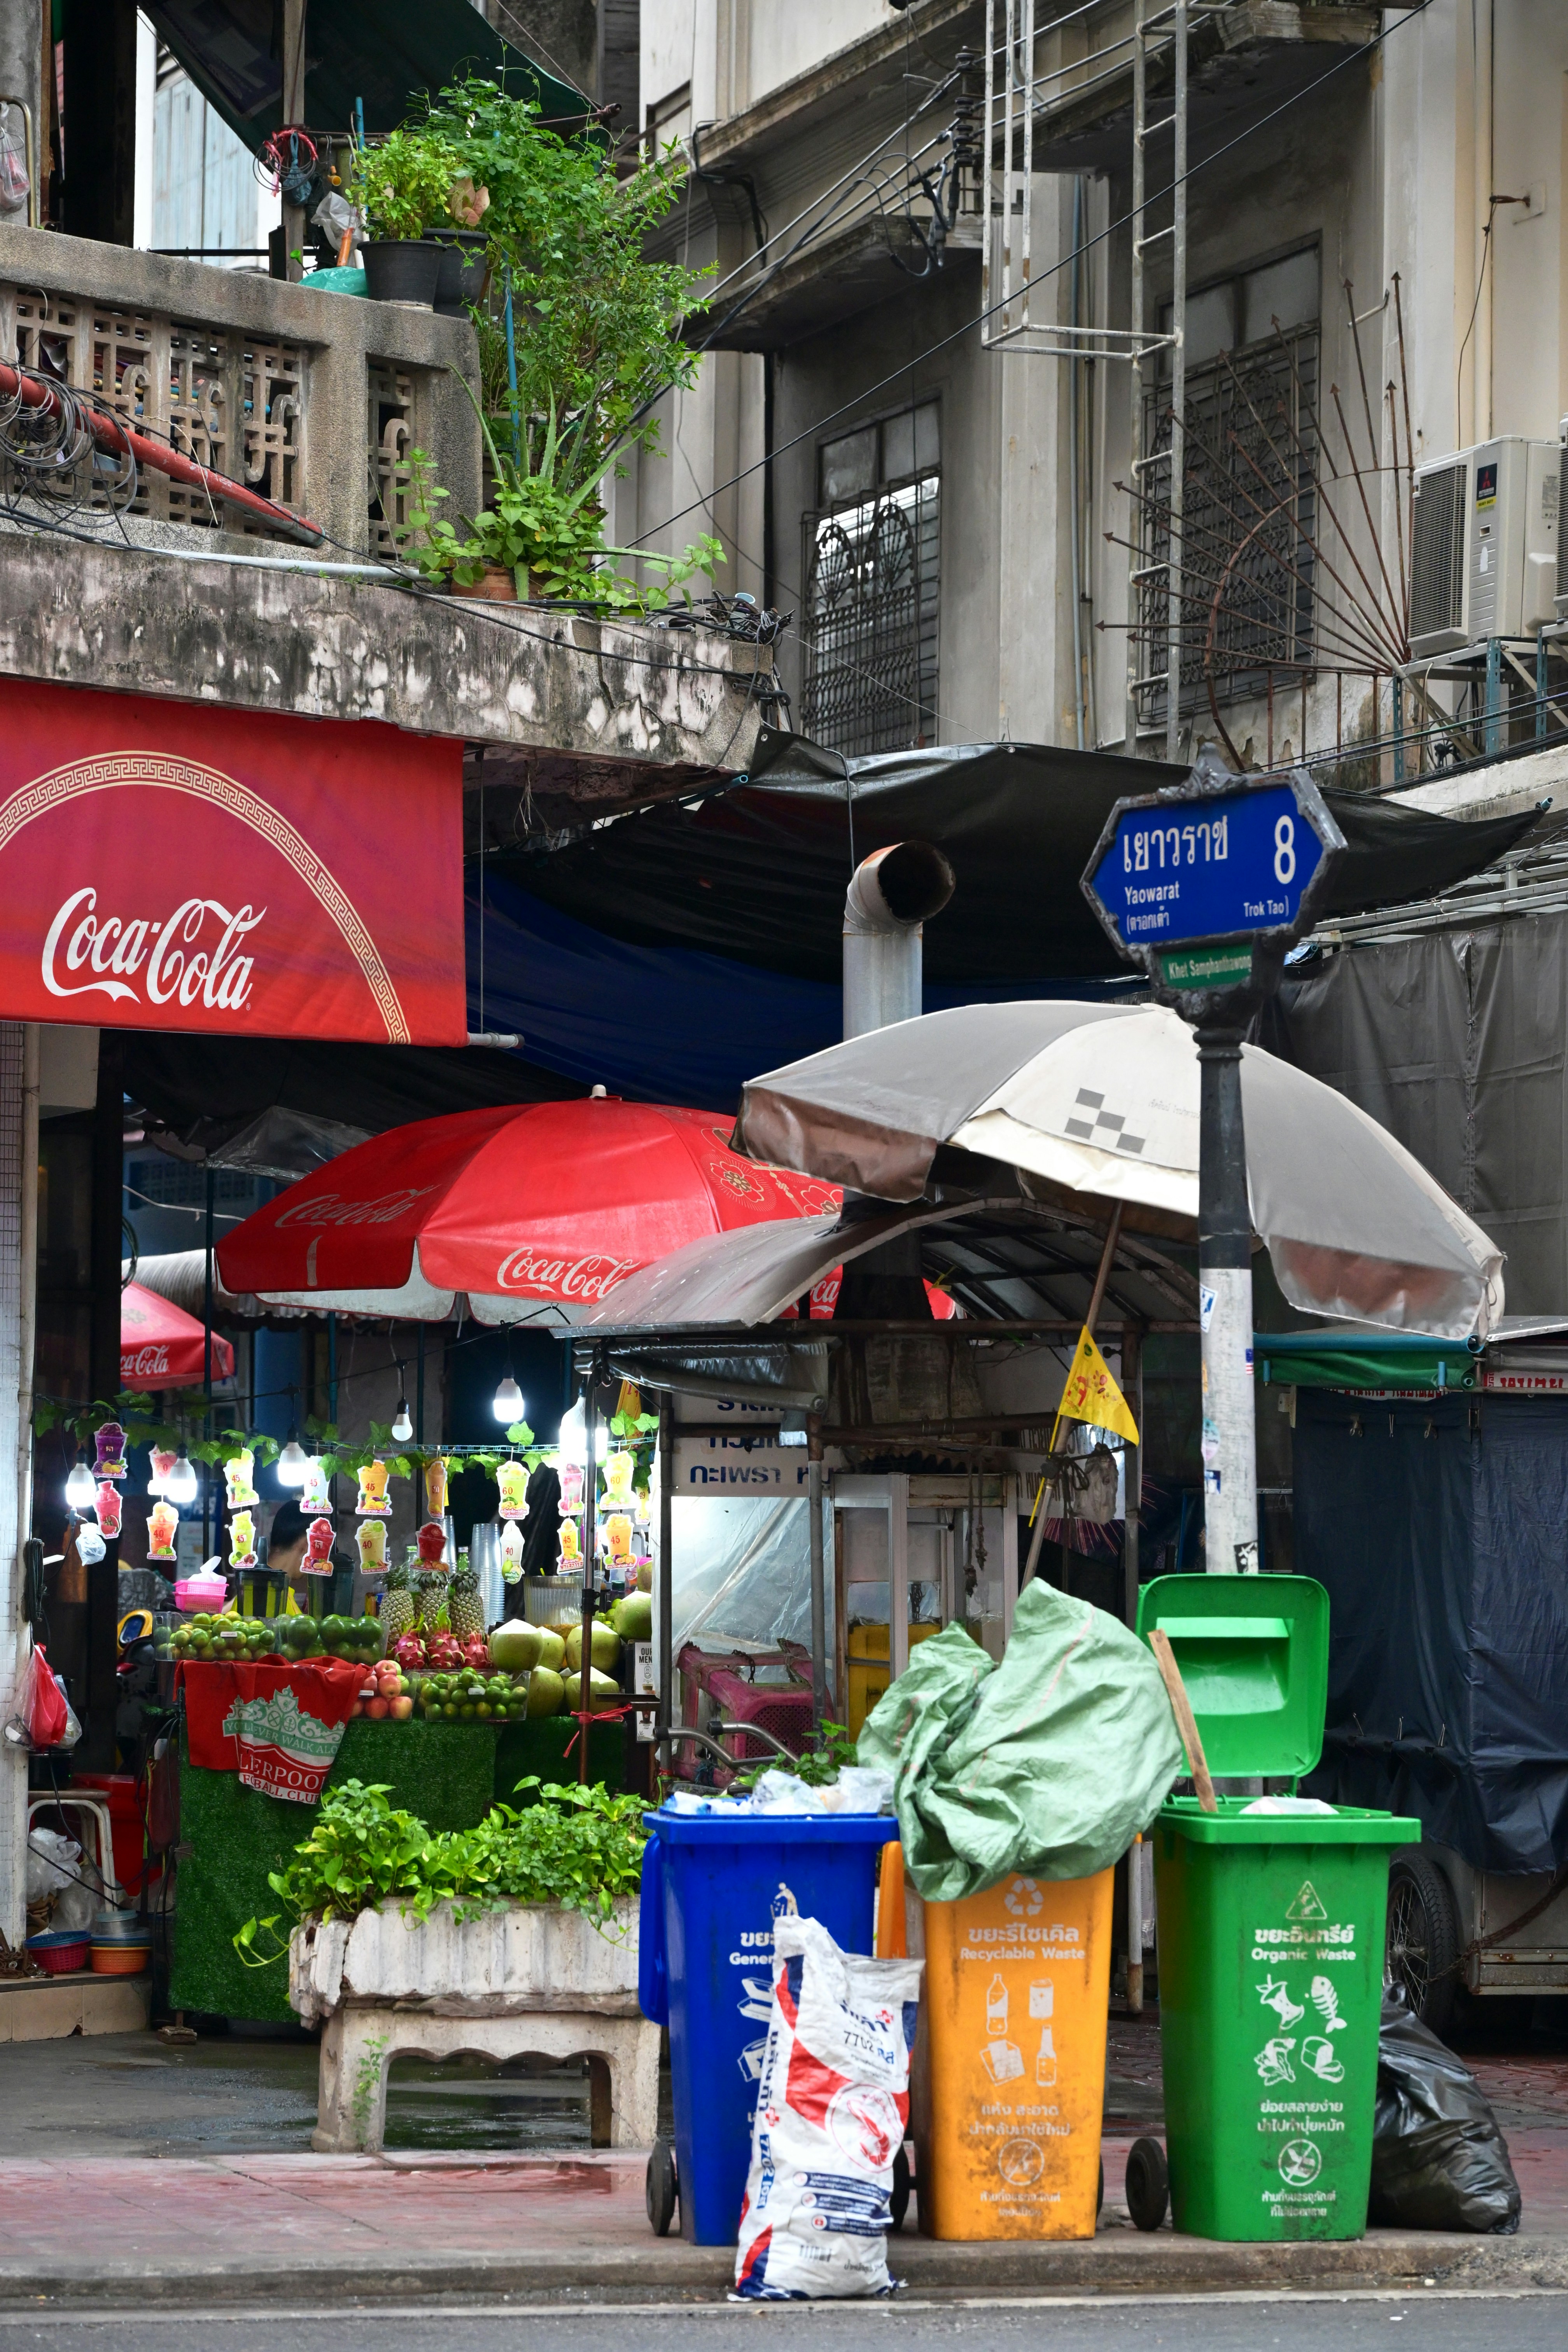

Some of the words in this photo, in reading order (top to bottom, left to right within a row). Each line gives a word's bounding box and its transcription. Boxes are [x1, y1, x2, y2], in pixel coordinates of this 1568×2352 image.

[1124, 815, 1228, 873] เยาวราช
[1274, 815, 1296, 885] 8
[1125, 881, 1180, 905] Yaowarat
[1243, 901, 1265, 917] Trok
[1267, 895, 1289, 917] Tao)
[41, 887, 268, 1010] Coca-Cola
[1169, 962, 1188, 980] Khet
[275, 1184, 442, 1228] Coca-Cola
[232, 1474, 240, 1482] 45
[611, 1476, 620, 1484] 60
[154, 1529, 164, 1537] 40
[236, 1535, 244, 1543] 45
[564, 1536, 571, 1544] 45
[611, 1536, 620, 1544] 45
[312, 1541, 321, 1550] 45
[362, 1540, 372, 1549] 40
[506, 1547, 513, 1555] 40
[282, 1735, 315, 1752] WALK
[969, 1922, 1080, 1943] ขยะรีไซเคิล
[1255, 1923, 1355, 1943] ขยะอินทรีย์
[961, 1946, 1035, 1962] Recyclable
[1041, 1946, 1085, 1959] Waste
[1251, 1947, 1308, 1964] Organic
[1316, 1948, 1356, 1960] Waste
[1016, 2104, 1059, 2116] สะอาด
[1261, 2099, 1344, 2113] ย่อยสลายง่าย
[1257, 2115, 1345, 2136] นำไปทำปุ๋ยหมัก
